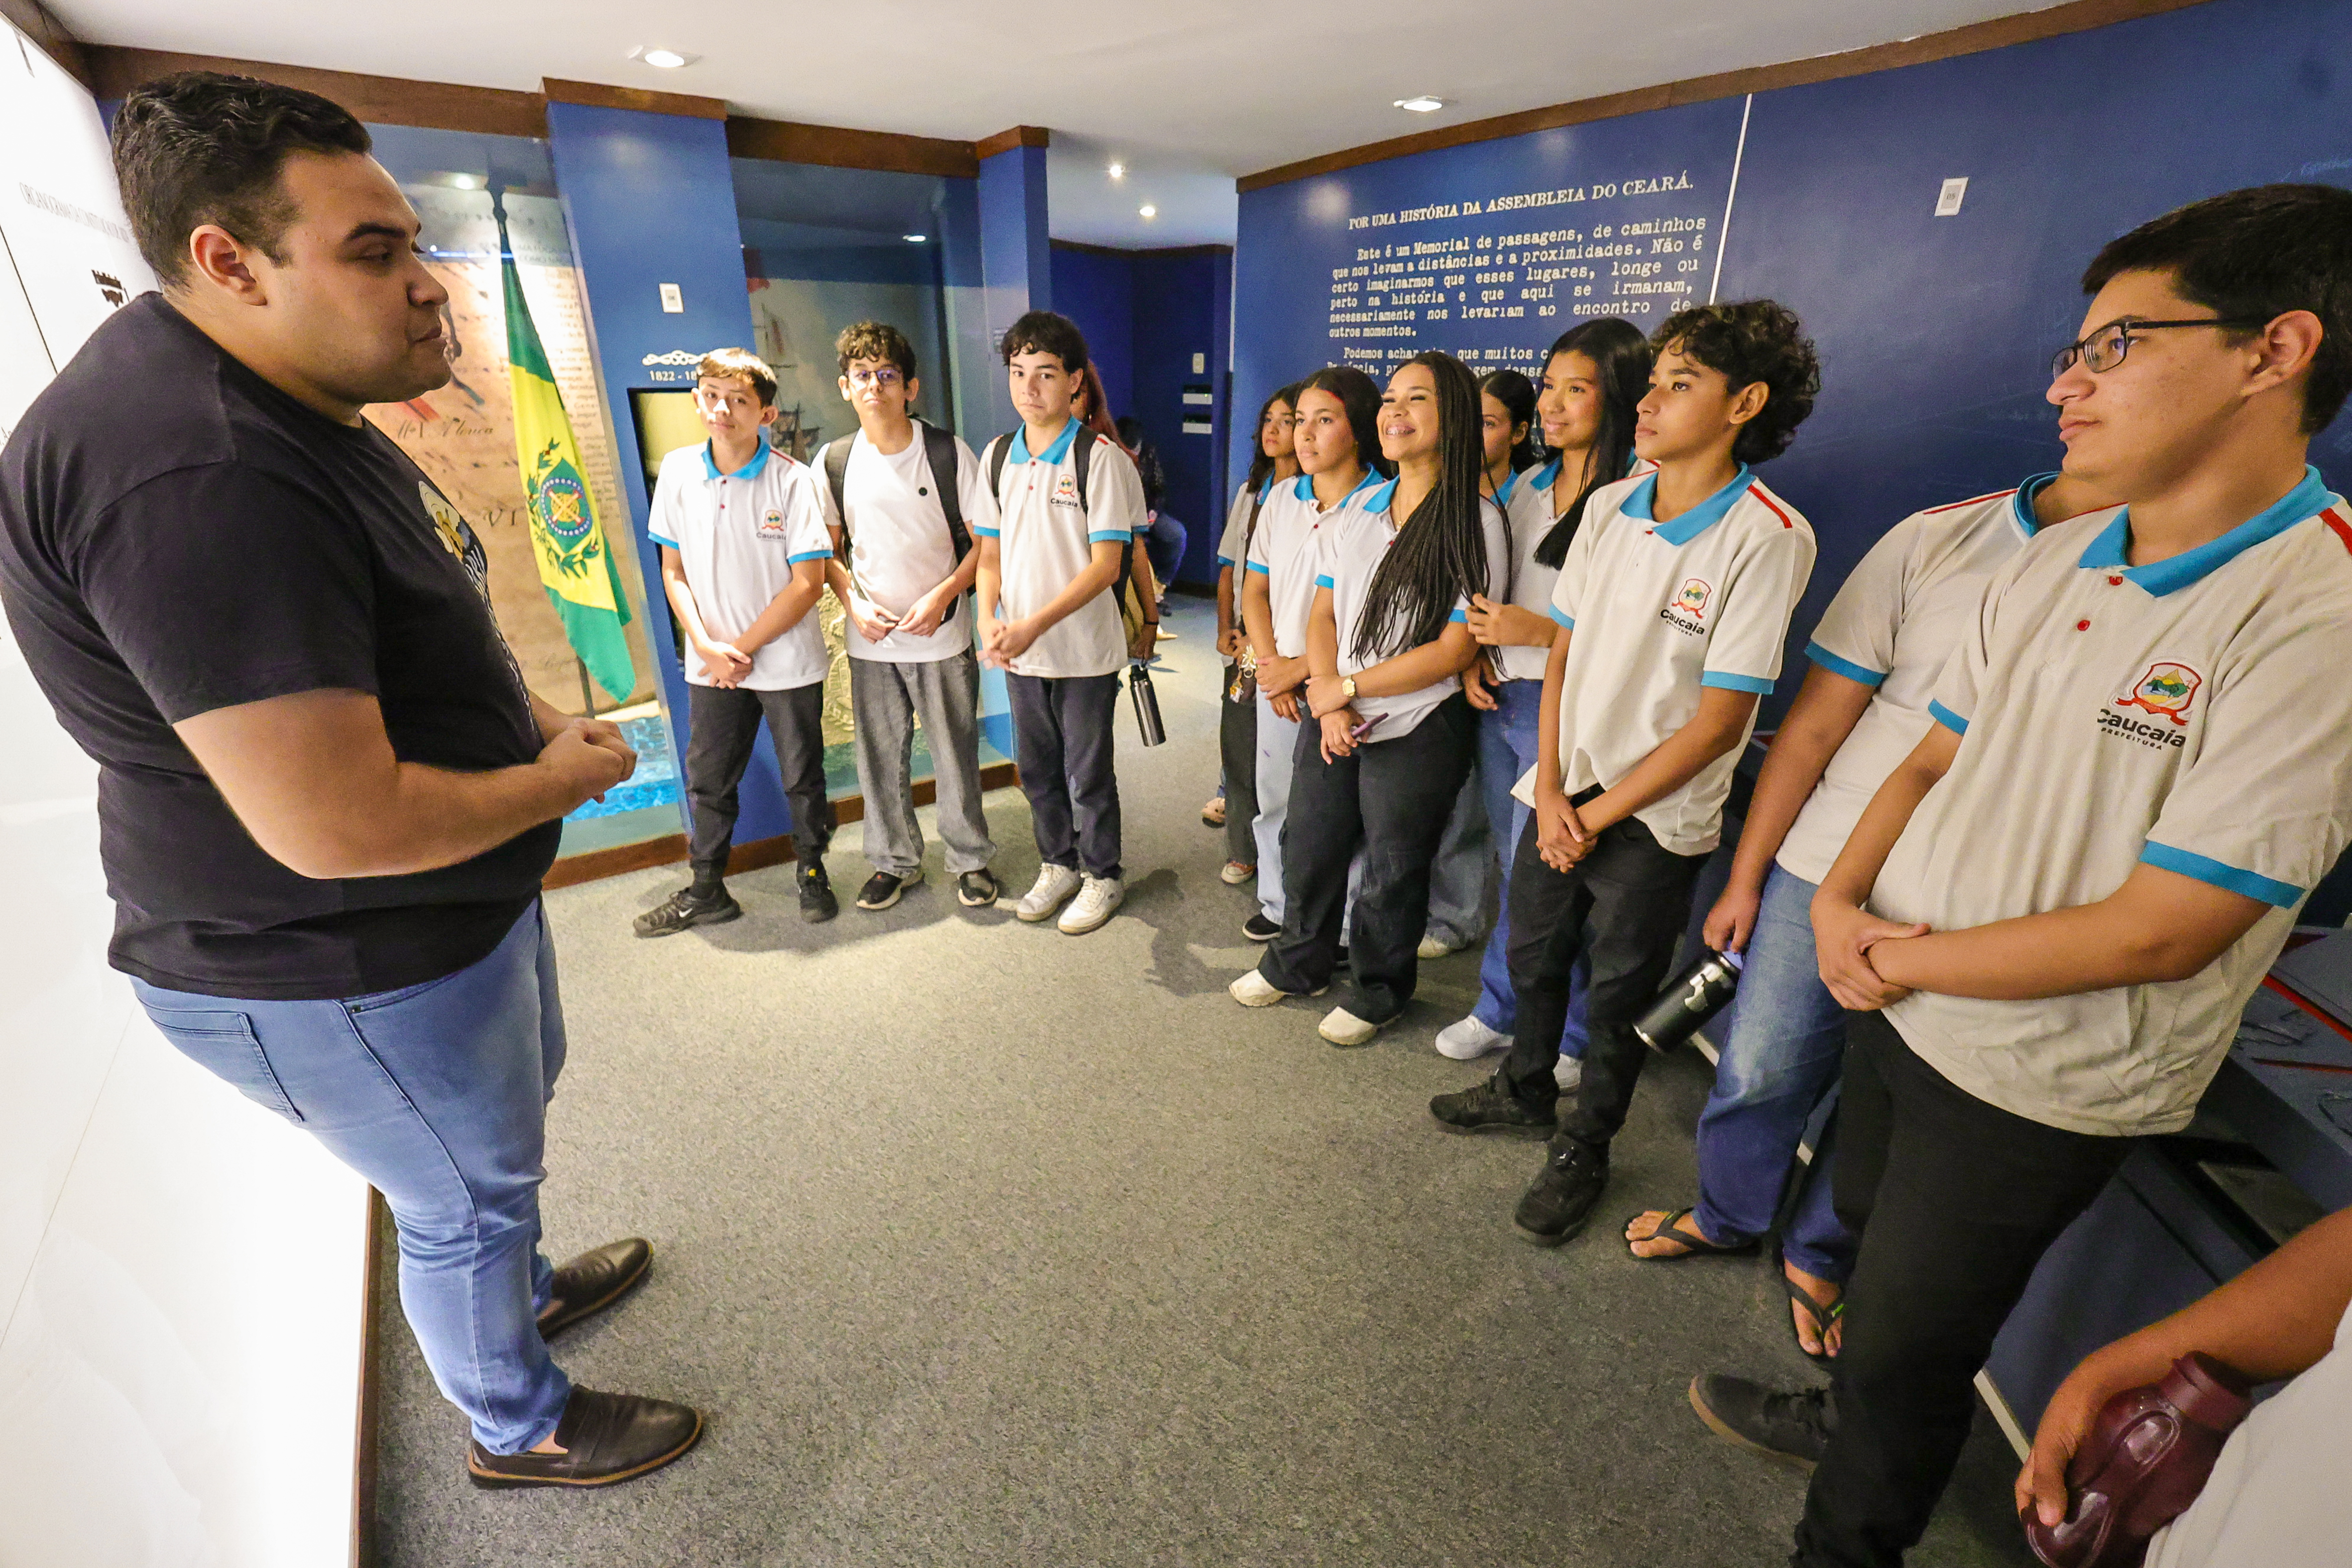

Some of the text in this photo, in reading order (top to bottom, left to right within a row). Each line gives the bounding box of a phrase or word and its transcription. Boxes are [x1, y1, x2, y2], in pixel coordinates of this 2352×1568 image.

[1349, 170, 1694, 230] POR UMA HISTÓRIA DA ASSEMBLEIA DO CEARÁ.
[1357, 217, 1706, 261] Este é um Memorial de passagens, de caminhos
[1332, 234, 1703, 279] que nos levam a distâncias e a proximidades. Não é
[1332, 258, 1698, 294] certo imaginarmos que esses lugares, longe ou
[1330, 280, 1693, 311] perto na história e que aqui se irmanam,
[1330, 298, 1692, 324] necessariamente nos levariam ao encontro de
[1329, 326, 1417, 338] outros momentos.
[1343, 348, 1383, 359] Podemos
[1387, 348, 1419, 359] achar
[1457, 349, 1479, 361] que
[1484, 347, 1533, 360] muitos
[649, 370, 676, 381] 1822
[1051, 498, 1078, 508] Caucaia
[1660, 609, 1705, 635] Caucaia
[2097, 709, 2186, 747] Caucaia
[2101, 727, 2162, 750] PREFEITURA
